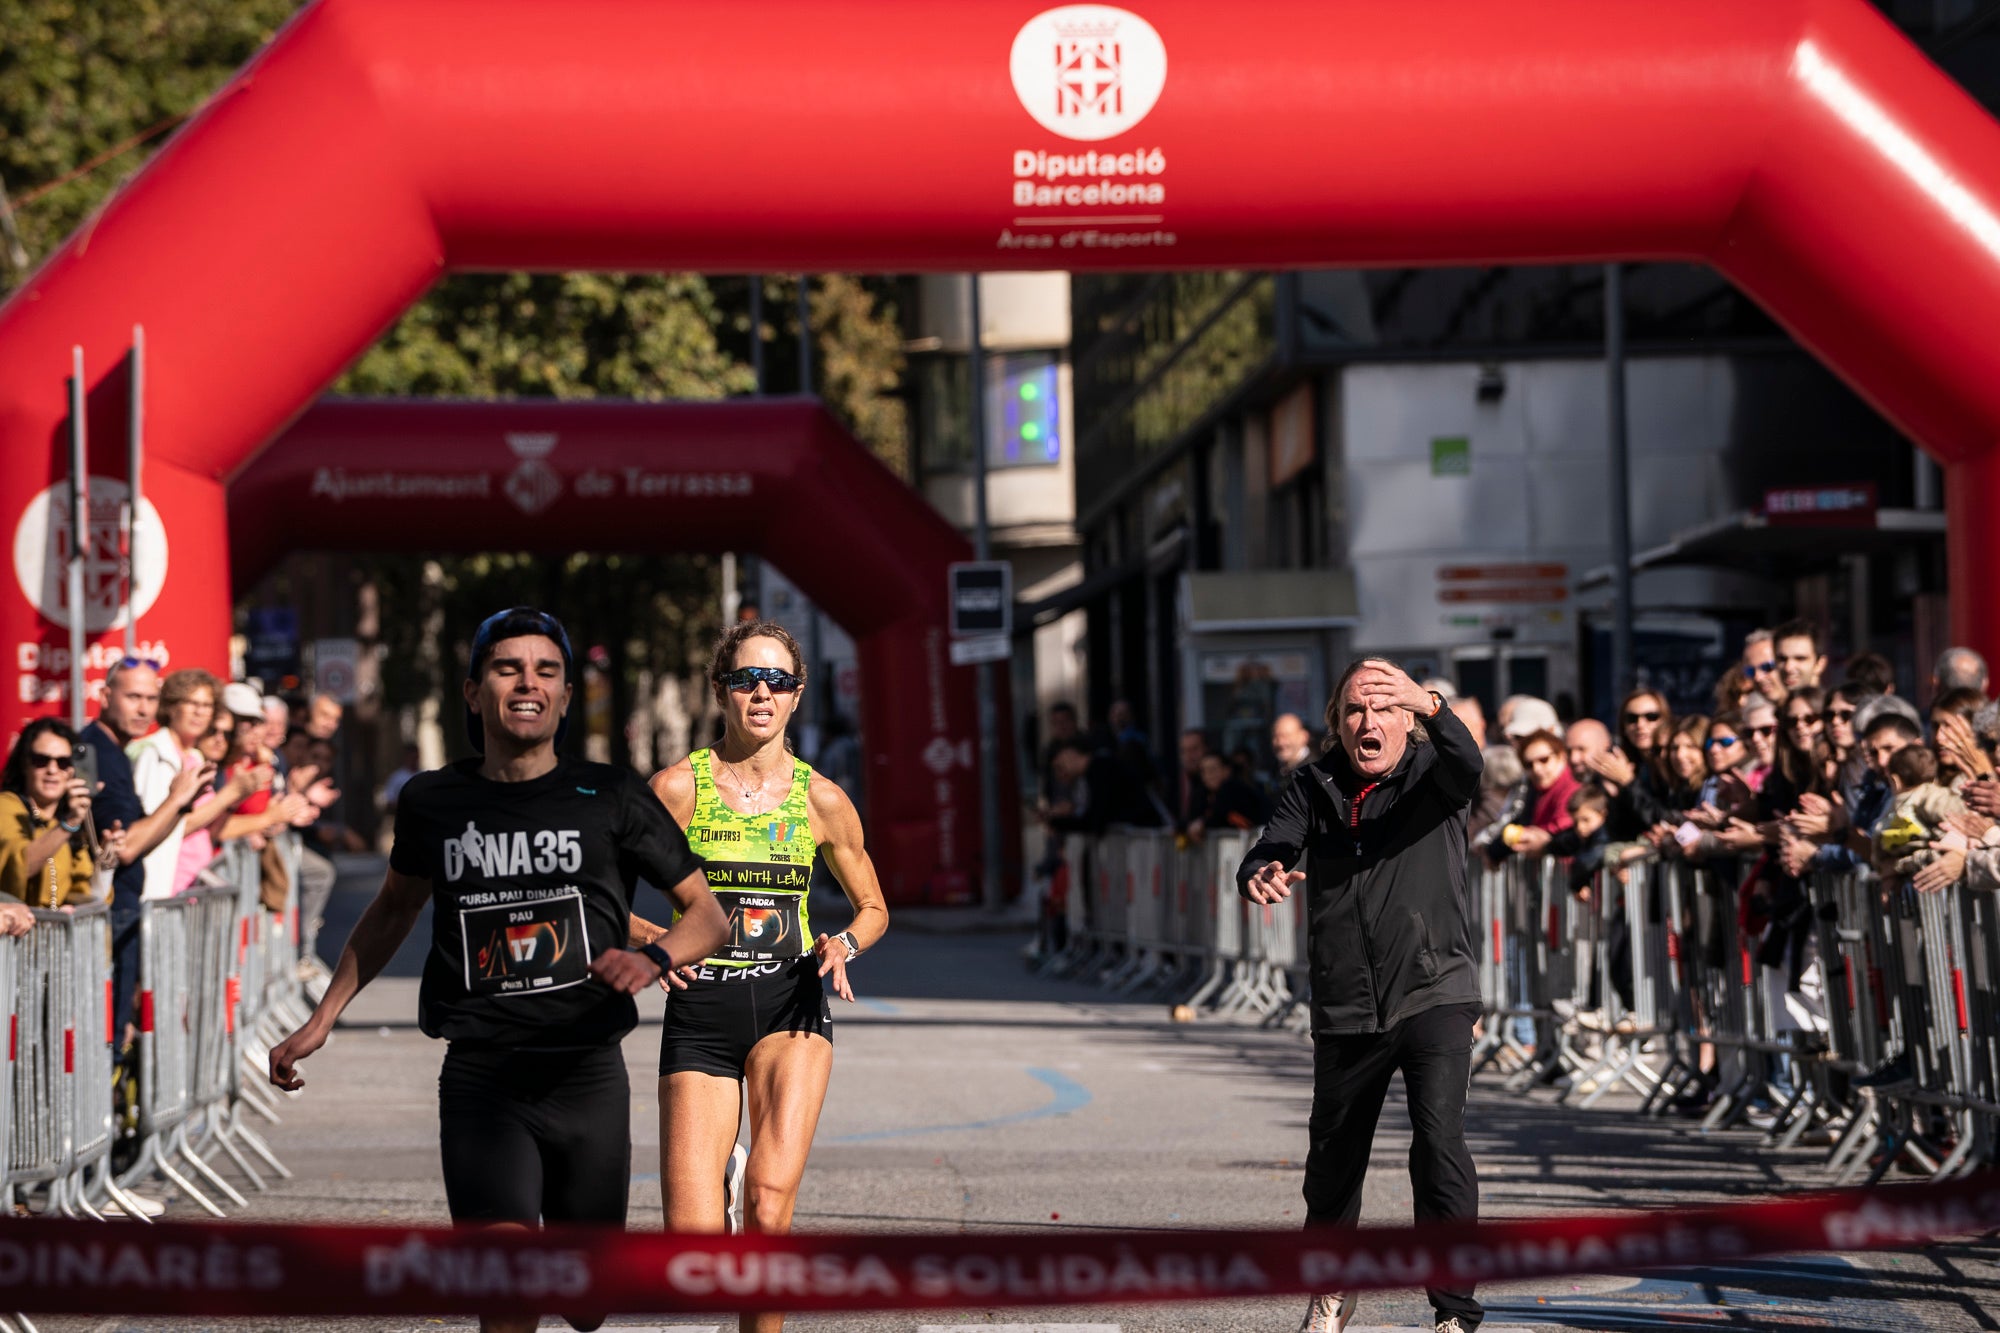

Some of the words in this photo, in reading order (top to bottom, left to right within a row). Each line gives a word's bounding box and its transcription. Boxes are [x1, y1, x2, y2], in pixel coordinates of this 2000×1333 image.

[1013, 147, 1166, 181] Diputació
[1013, 179, 1165, 206] Barcelona
[312, 466, 491, 502] Ajuntament
[575, 470, 614, 497] de
[623, 466, 753, 497] Terrassa
[707, 870, 732, 883] RUN
[738, 869, 772, 885] WITH
[460, 892, 497, 905] CURSA
[500, 890, 523, 901] PAU
[740, 897, 775, 906] SANDRA
[509, 911, 534, 922] PAU
[749, 919, 763, 937] 3
[511, 937, 537, 962] 17
[666, 1250, 898, 1296] CURSA
[913, 1243, 1267, 1295] SOLIDÀRIA
[1301, 1247, 1433, 1286] PAU
